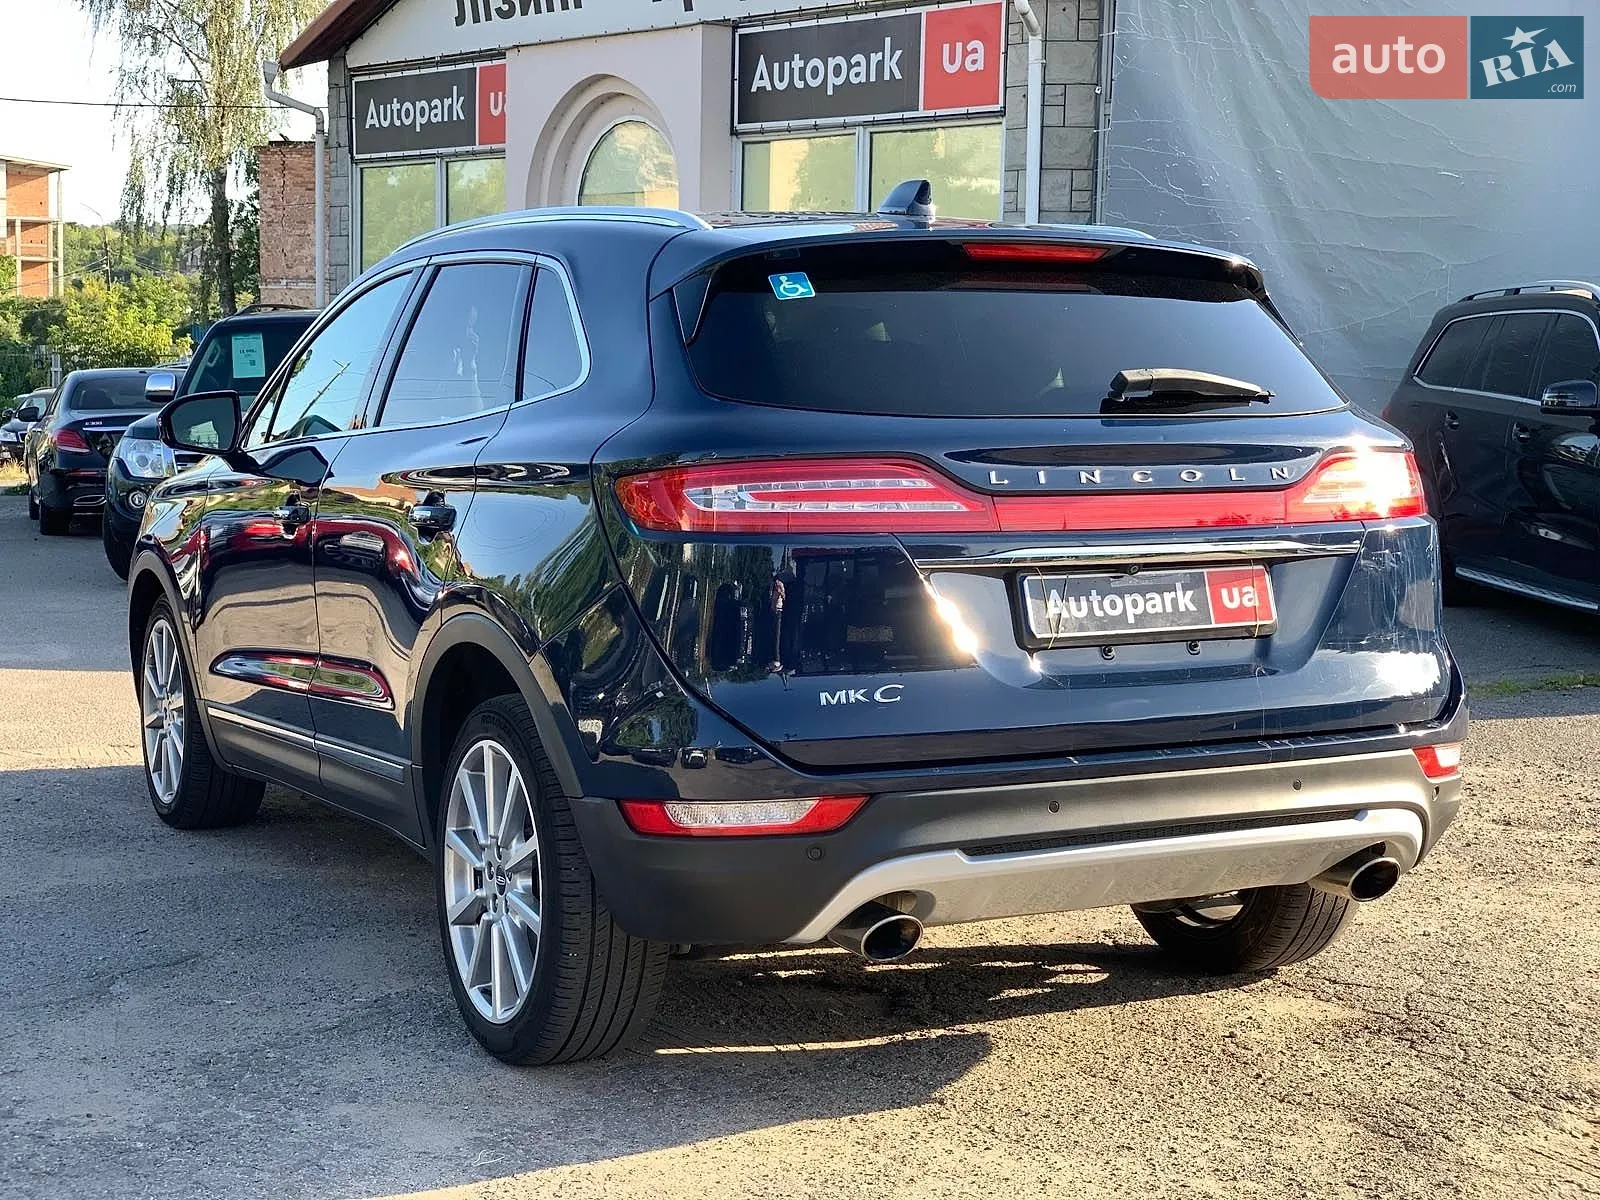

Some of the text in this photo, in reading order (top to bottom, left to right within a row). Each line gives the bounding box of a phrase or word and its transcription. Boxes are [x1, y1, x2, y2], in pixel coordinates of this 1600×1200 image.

[750, 36, 985, 96] Autopark ua
[365, 85, 507, 132] Autopark u
[990, 466, 1292, 486] LINCOLN
[1046, 581, 1260, 624] Autopark ua
[819, 684, 905, 707] MKC
